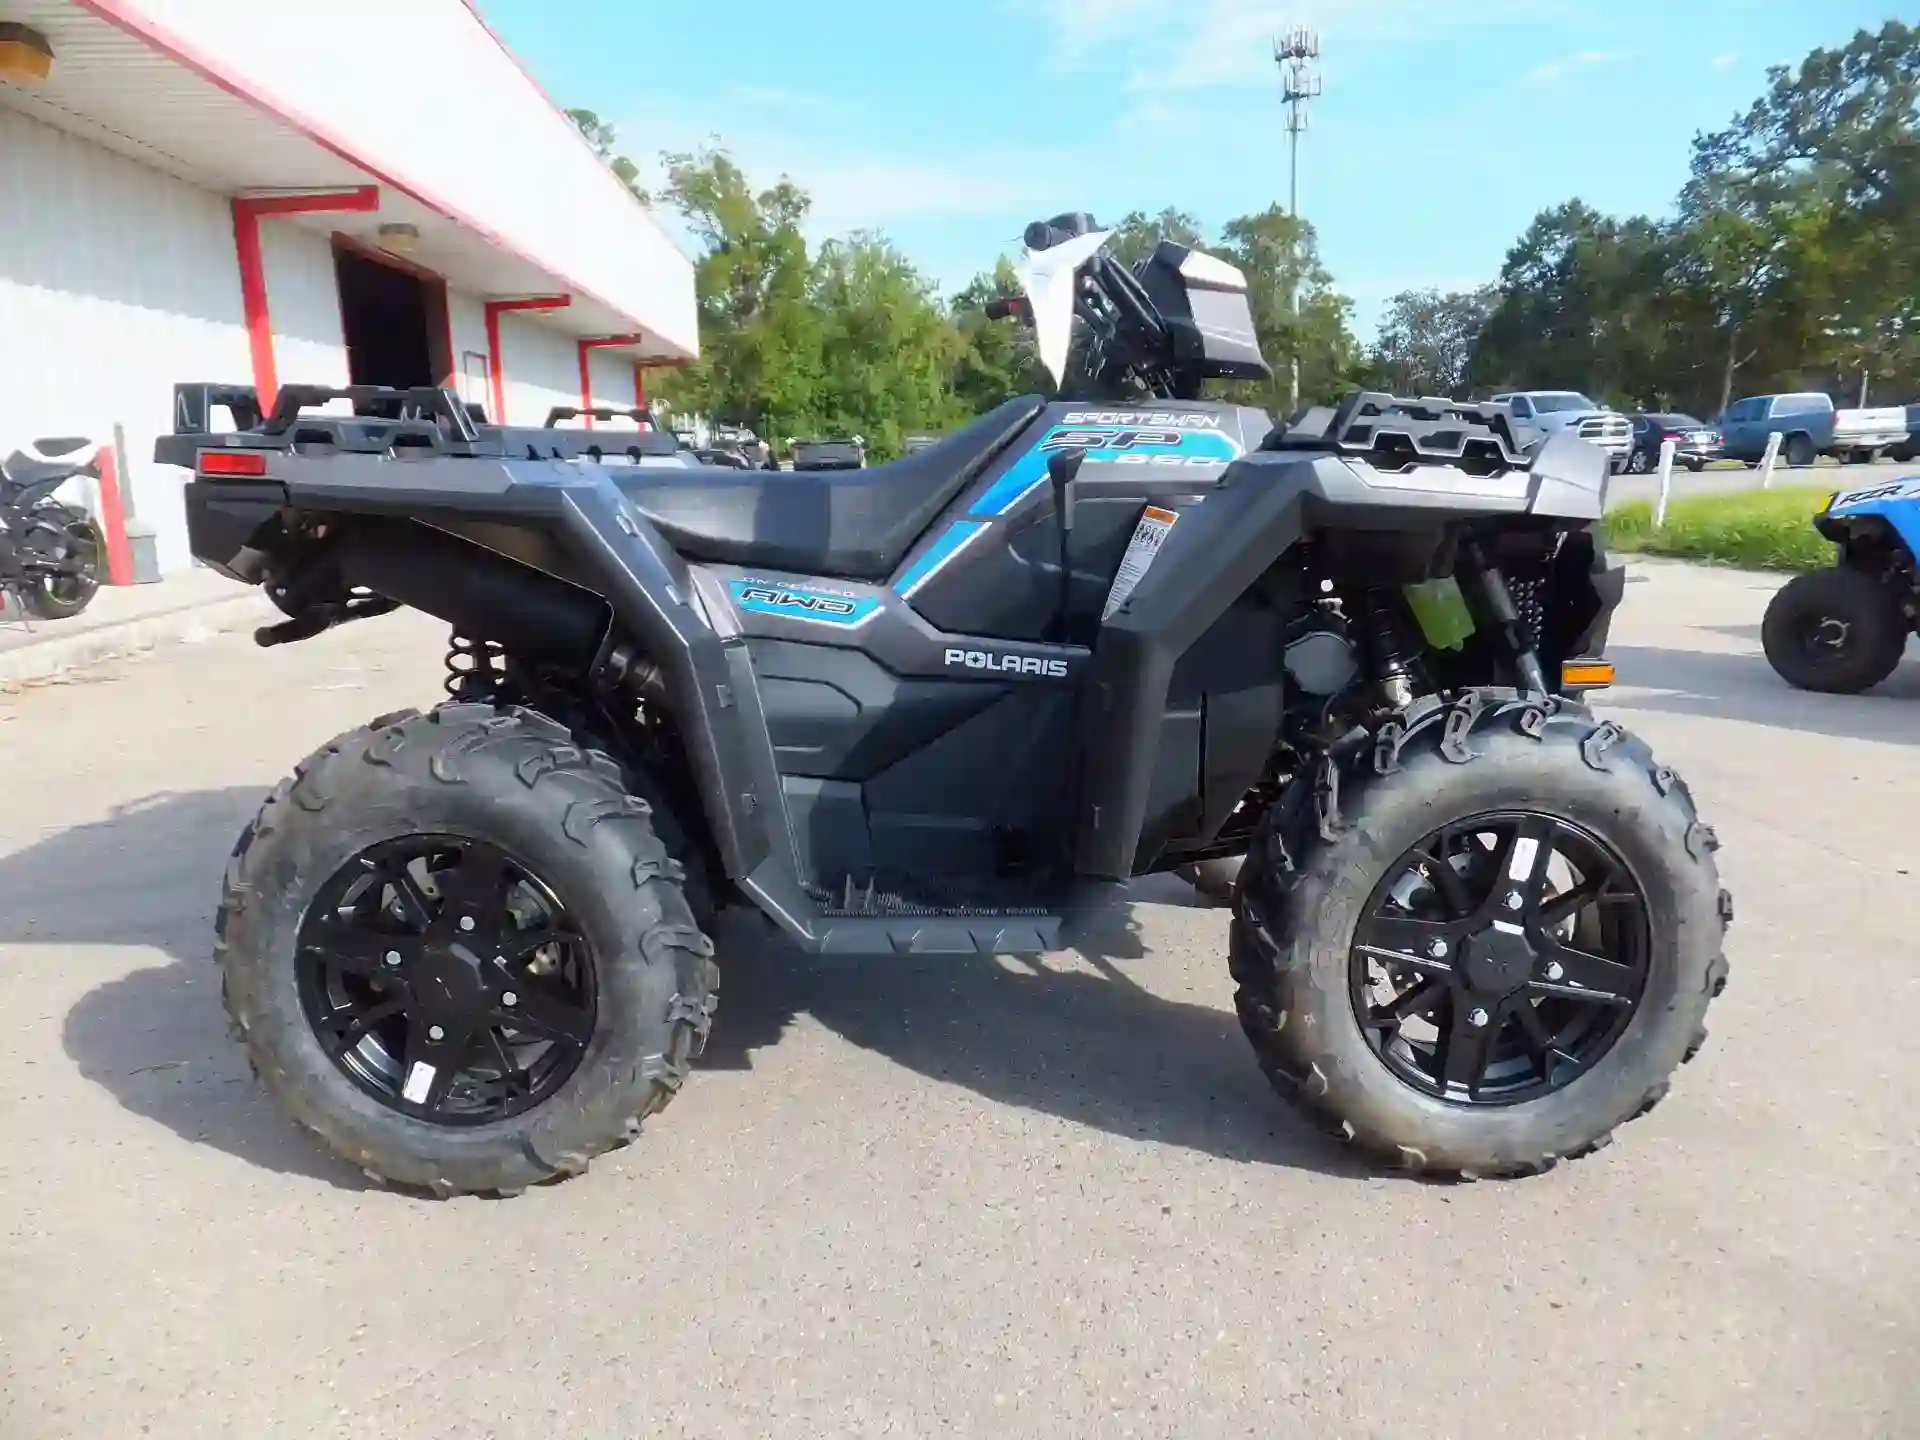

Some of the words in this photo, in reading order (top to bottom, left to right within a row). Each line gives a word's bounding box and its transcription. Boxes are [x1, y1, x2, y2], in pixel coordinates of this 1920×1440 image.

[1062, 412, 1221, 428] SPORTSMAN
[1039, 429, 1184, 450] SP
[740, 587, 857, 615] AWD
[944, 648, 1068, 677] POLARIS
